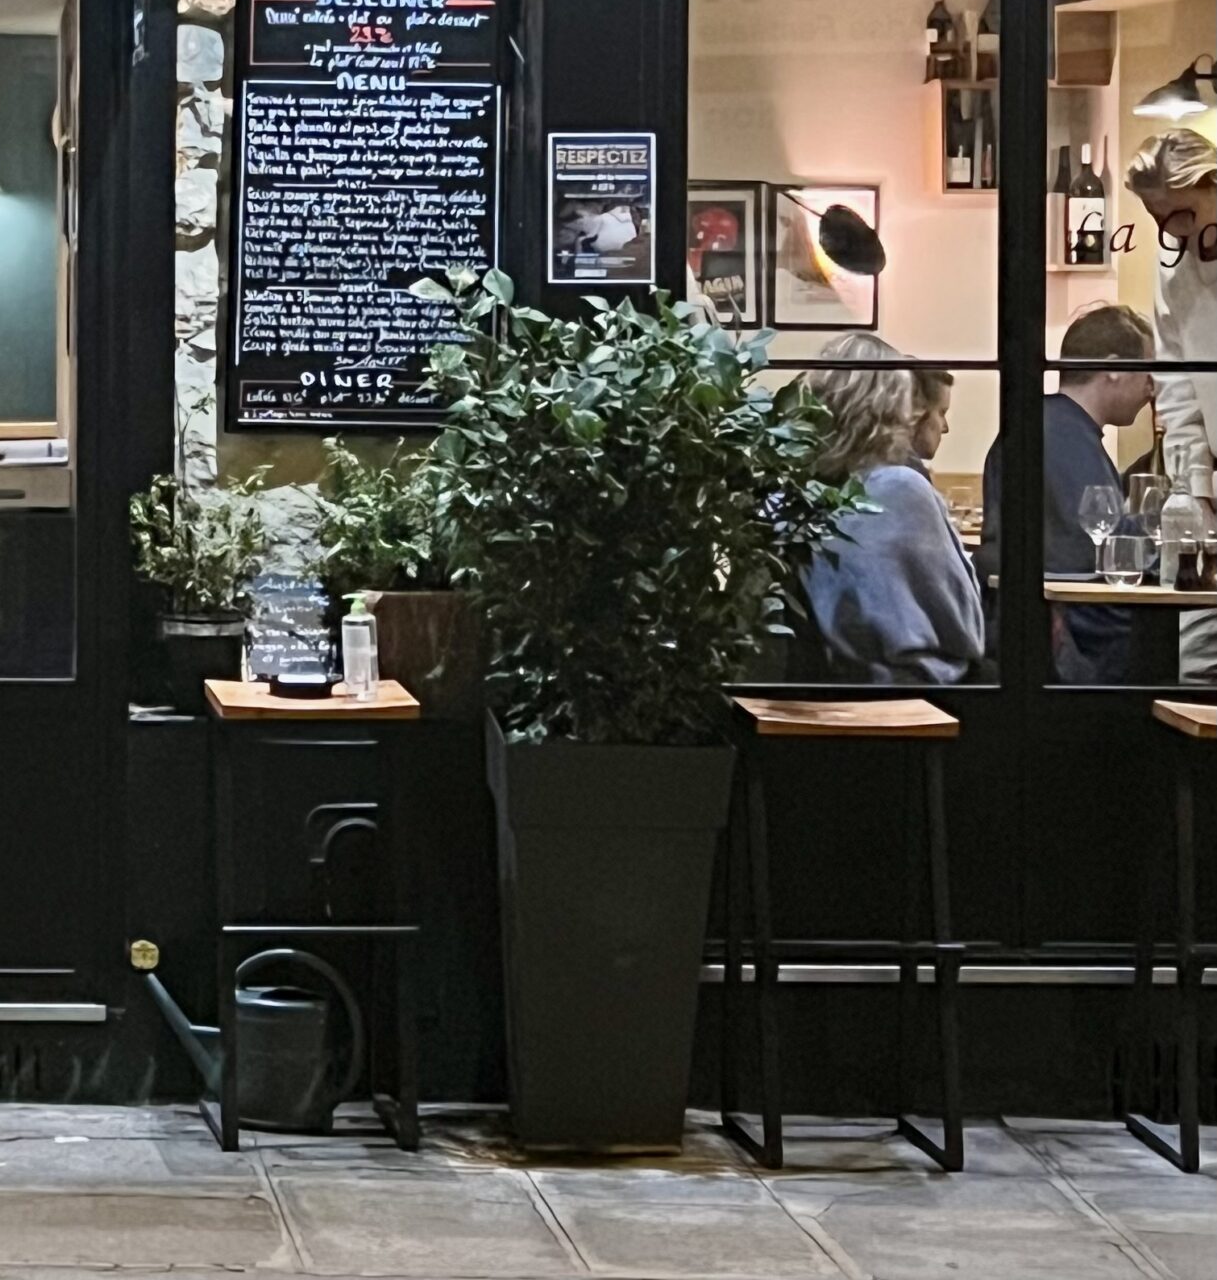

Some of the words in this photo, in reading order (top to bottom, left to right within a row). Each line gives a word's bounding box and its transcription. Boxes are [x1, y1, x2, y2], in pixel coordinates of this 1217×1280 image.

[556, 150, 648, 164] RESPECTEZ
[1069, 210, 1137, 253] La
[300, 371, 394, 388] DINER
